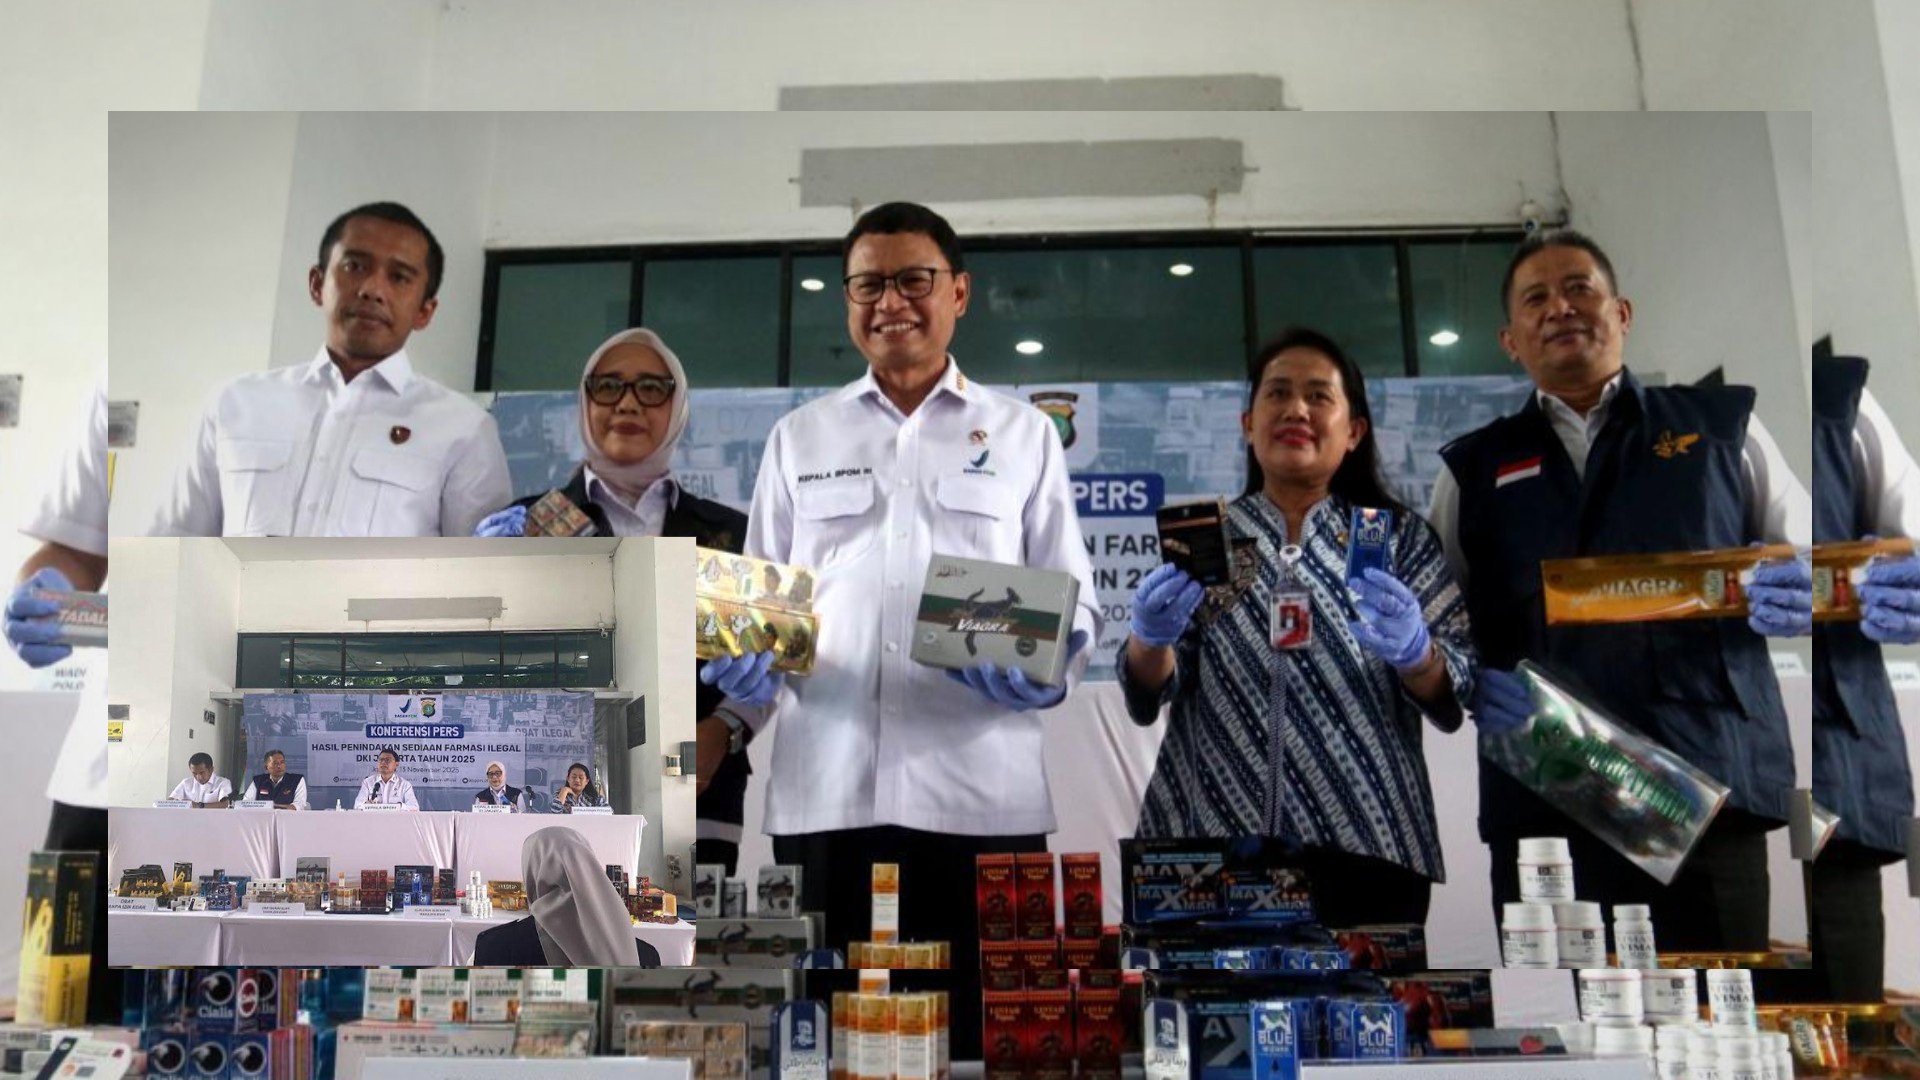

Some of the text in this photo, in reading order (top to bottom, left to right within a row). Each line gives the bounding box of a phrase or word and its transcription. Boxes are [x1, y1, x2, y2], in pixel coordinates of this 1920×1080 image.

[798, 472, 831, 483] KEPALA
[834, 468, 861, 478] BPOM
[1075, 481, 1148, 511] PERS
[957, 618, 1010, 633] VIAGRA
[370, 726, 460, 737] KONFERENSI PERS
[541, 728, 575, 738] ILEGAL
[311, 743, 521, 752] HASIL PENINDAKAN SEDIAAN FARMASI ILEGAL
[356, 754, 371, 762] DKI
[418, 755, 449, 763] TAHUN
[451, 755, 476, 763] 2025
[198, 1005, 233, 1018] Cialis
[1257, 1031, 1293, 1045] BLUE
[1358, 1032, 1394, 1047] BLUE
